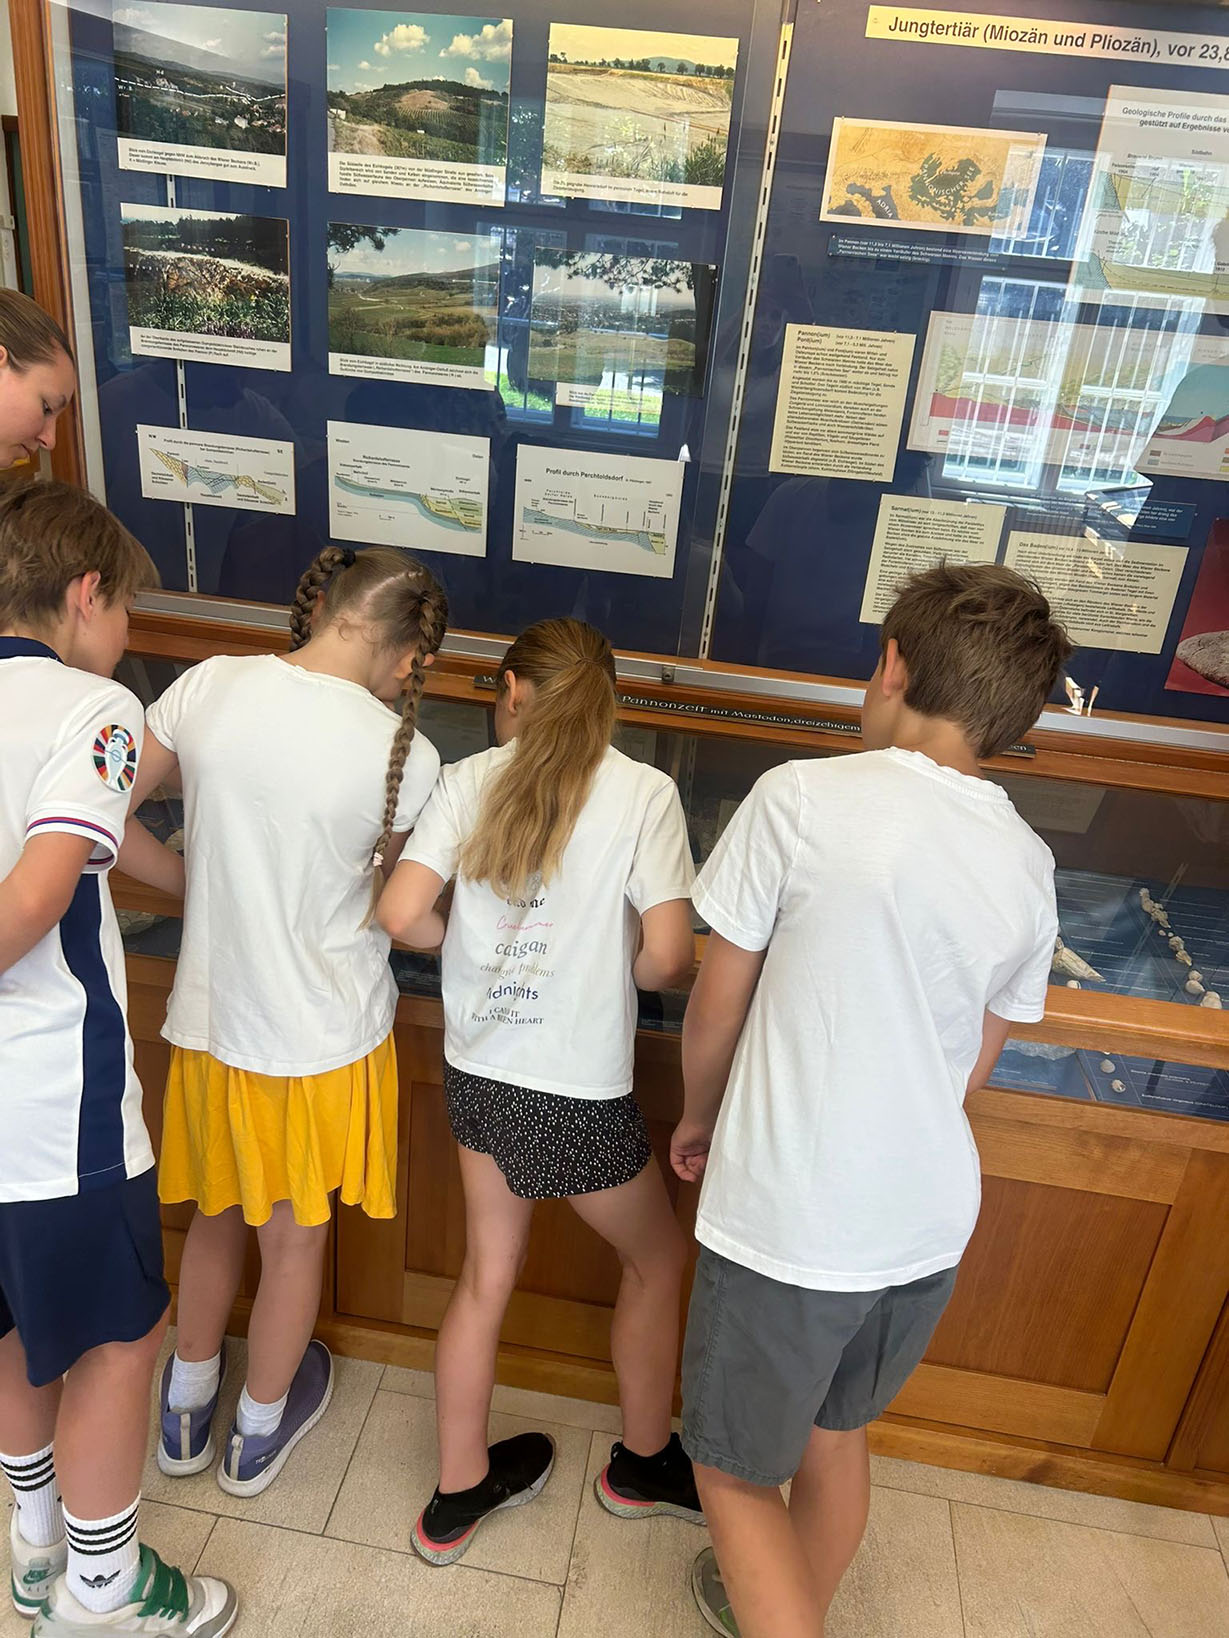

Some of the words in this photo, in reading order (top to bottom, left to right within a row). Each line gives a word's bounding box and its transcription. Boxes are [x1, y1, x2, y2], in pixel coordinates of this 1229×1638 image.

[888, 16, 979, 39] Jungtertiär
[983, 23, 1048, 45] (Miozän
[1053, 32, 1086, 48] und
[1089, 33, 1161, 58] Pliozän),
[1168, 44, 1196, 57] vor
[1121, 107, 1167, 119] Geologische
[1166, 110, 1191, 121] Profile
[1191, 112, 1213, 122] durch
[1213, 114, 1227, 124] das
[1138, 118, 1168, 129] gestützt
[1167, 120, 1181, 130] auf
[1180, 121, 1221, 133] Ergebnisse
[876, 199, 893, 218] ADRIA
[545, 467, 561, 475] Profil
[562, 469, 579, 477] durch
[579, 471, 623, 482] Perchtoldsdorf
[621, 695, 707, 713] Pannonzeit
[710, 707, 729, 716] mit
